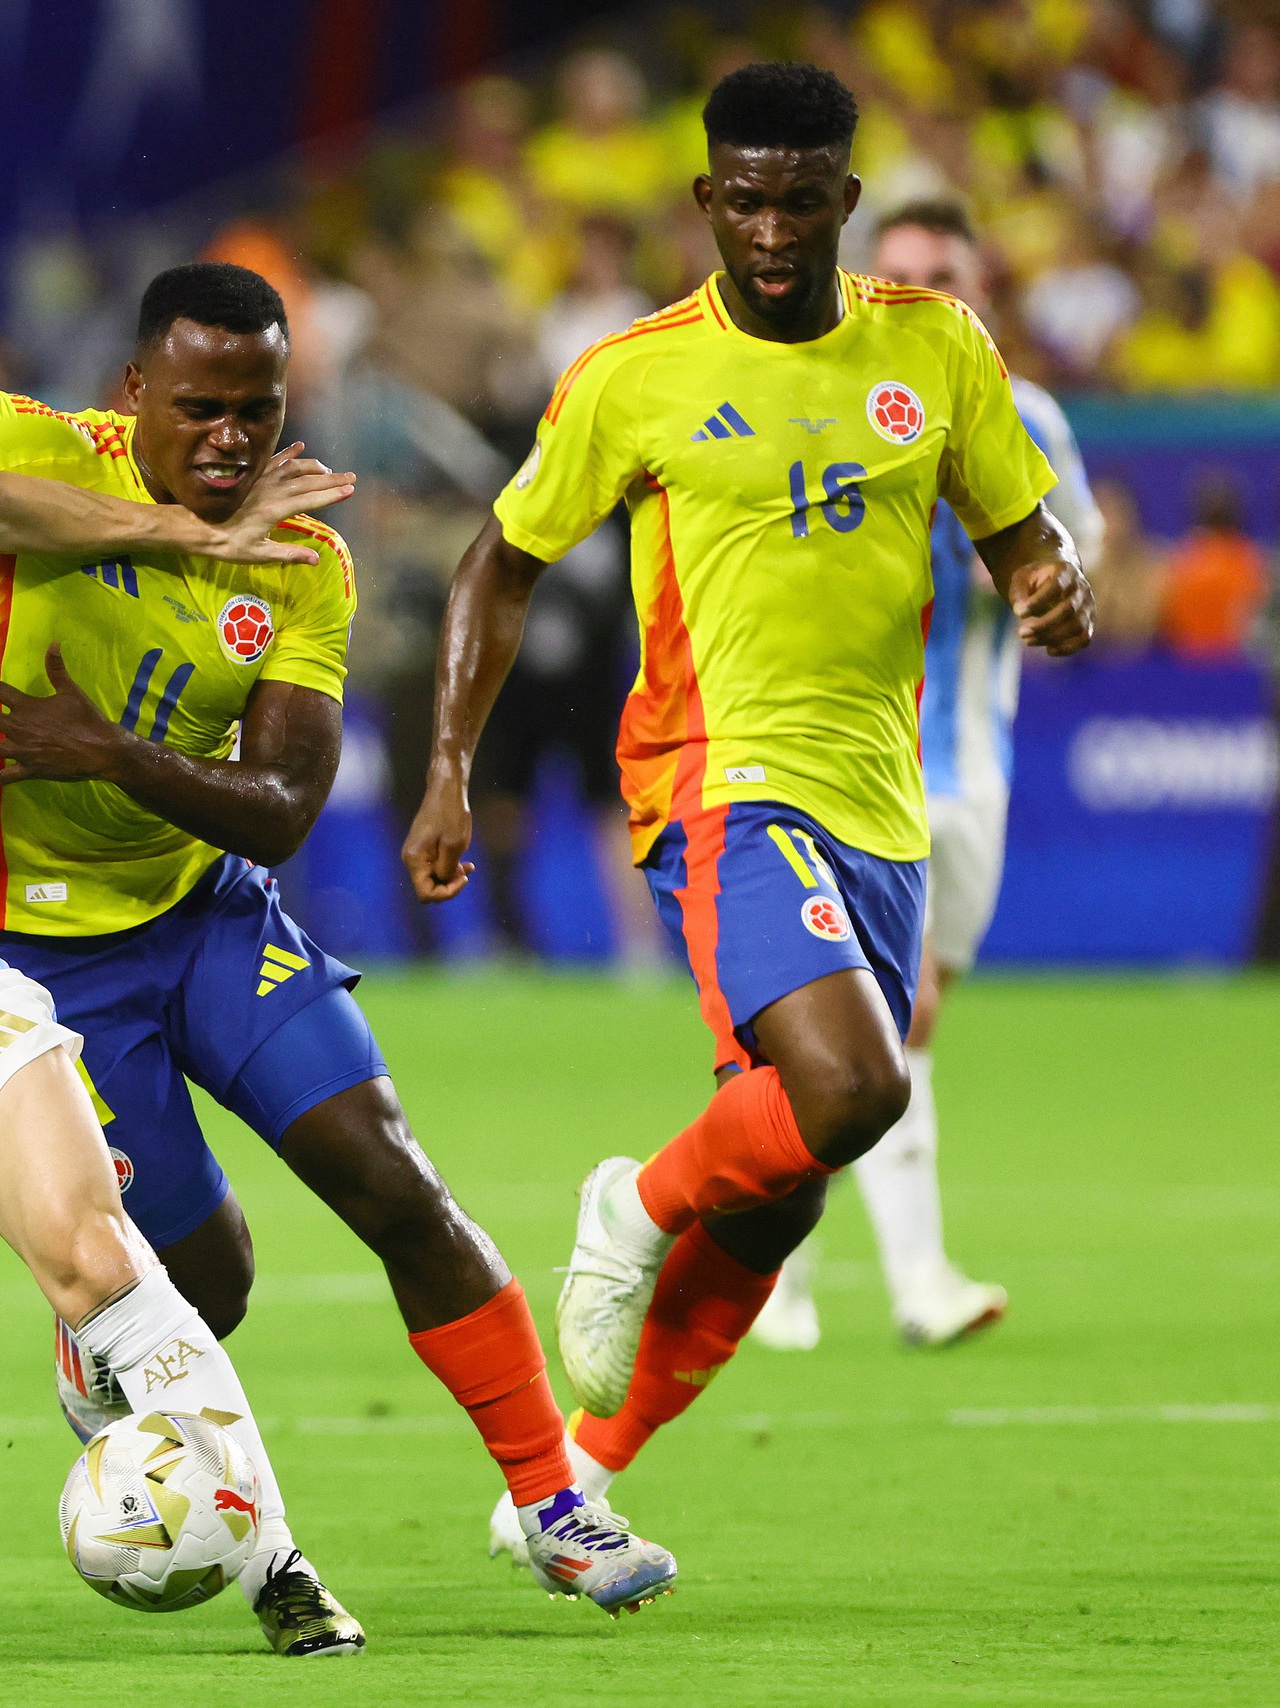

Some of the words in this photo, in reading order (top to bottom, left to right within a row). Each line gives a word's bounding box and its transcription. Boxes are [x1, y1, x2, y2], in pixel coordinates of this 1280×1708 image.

[788, 460, 868, 538] 16
[119, 647, 196, 743] 11
[141, 1338, 206, 1394] AFA
